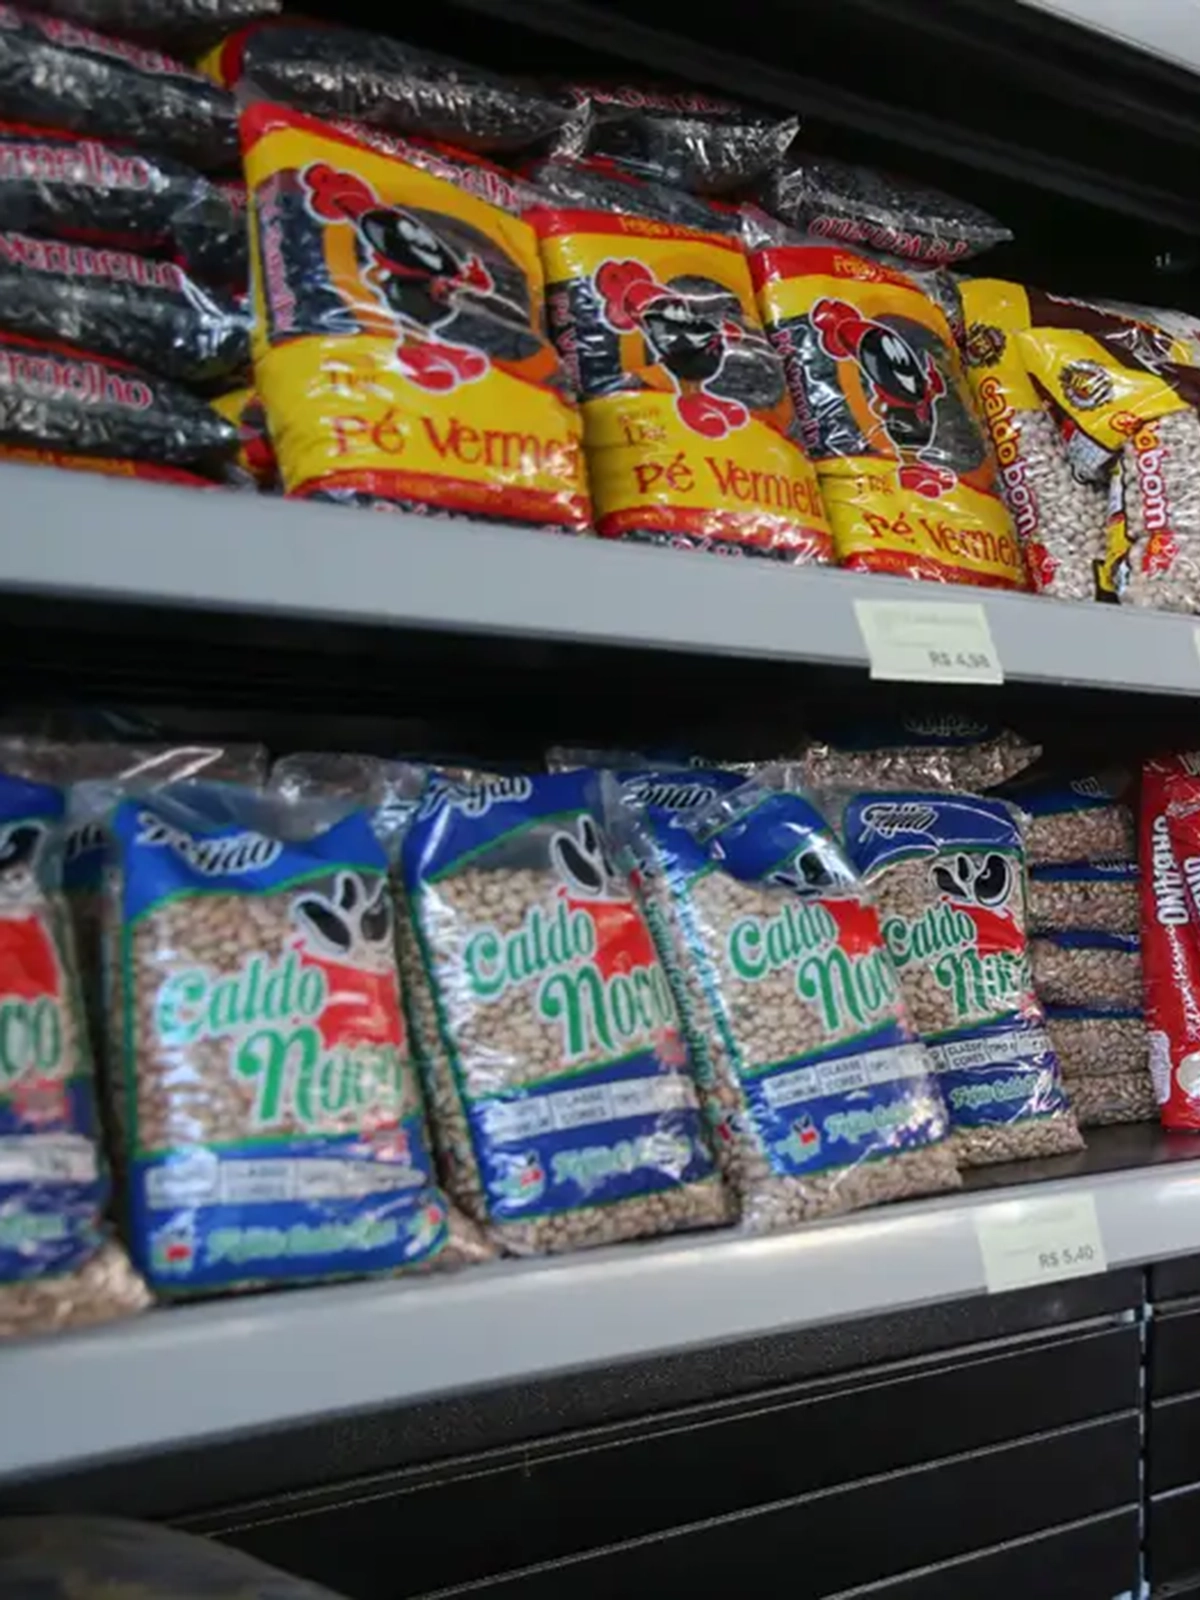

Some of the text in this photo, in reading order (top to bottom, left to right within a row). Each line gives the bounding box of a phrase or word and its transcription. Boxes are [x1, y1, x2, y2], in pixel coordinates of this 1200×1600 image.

[633, 451, 695, 494] Pé
[465, 901, 595, 996] Caldo
[729, 904, 837, 979] Caldo
[881, 903, 976, 967] Caldo
[157, 956, 327, 1040] Caldo
